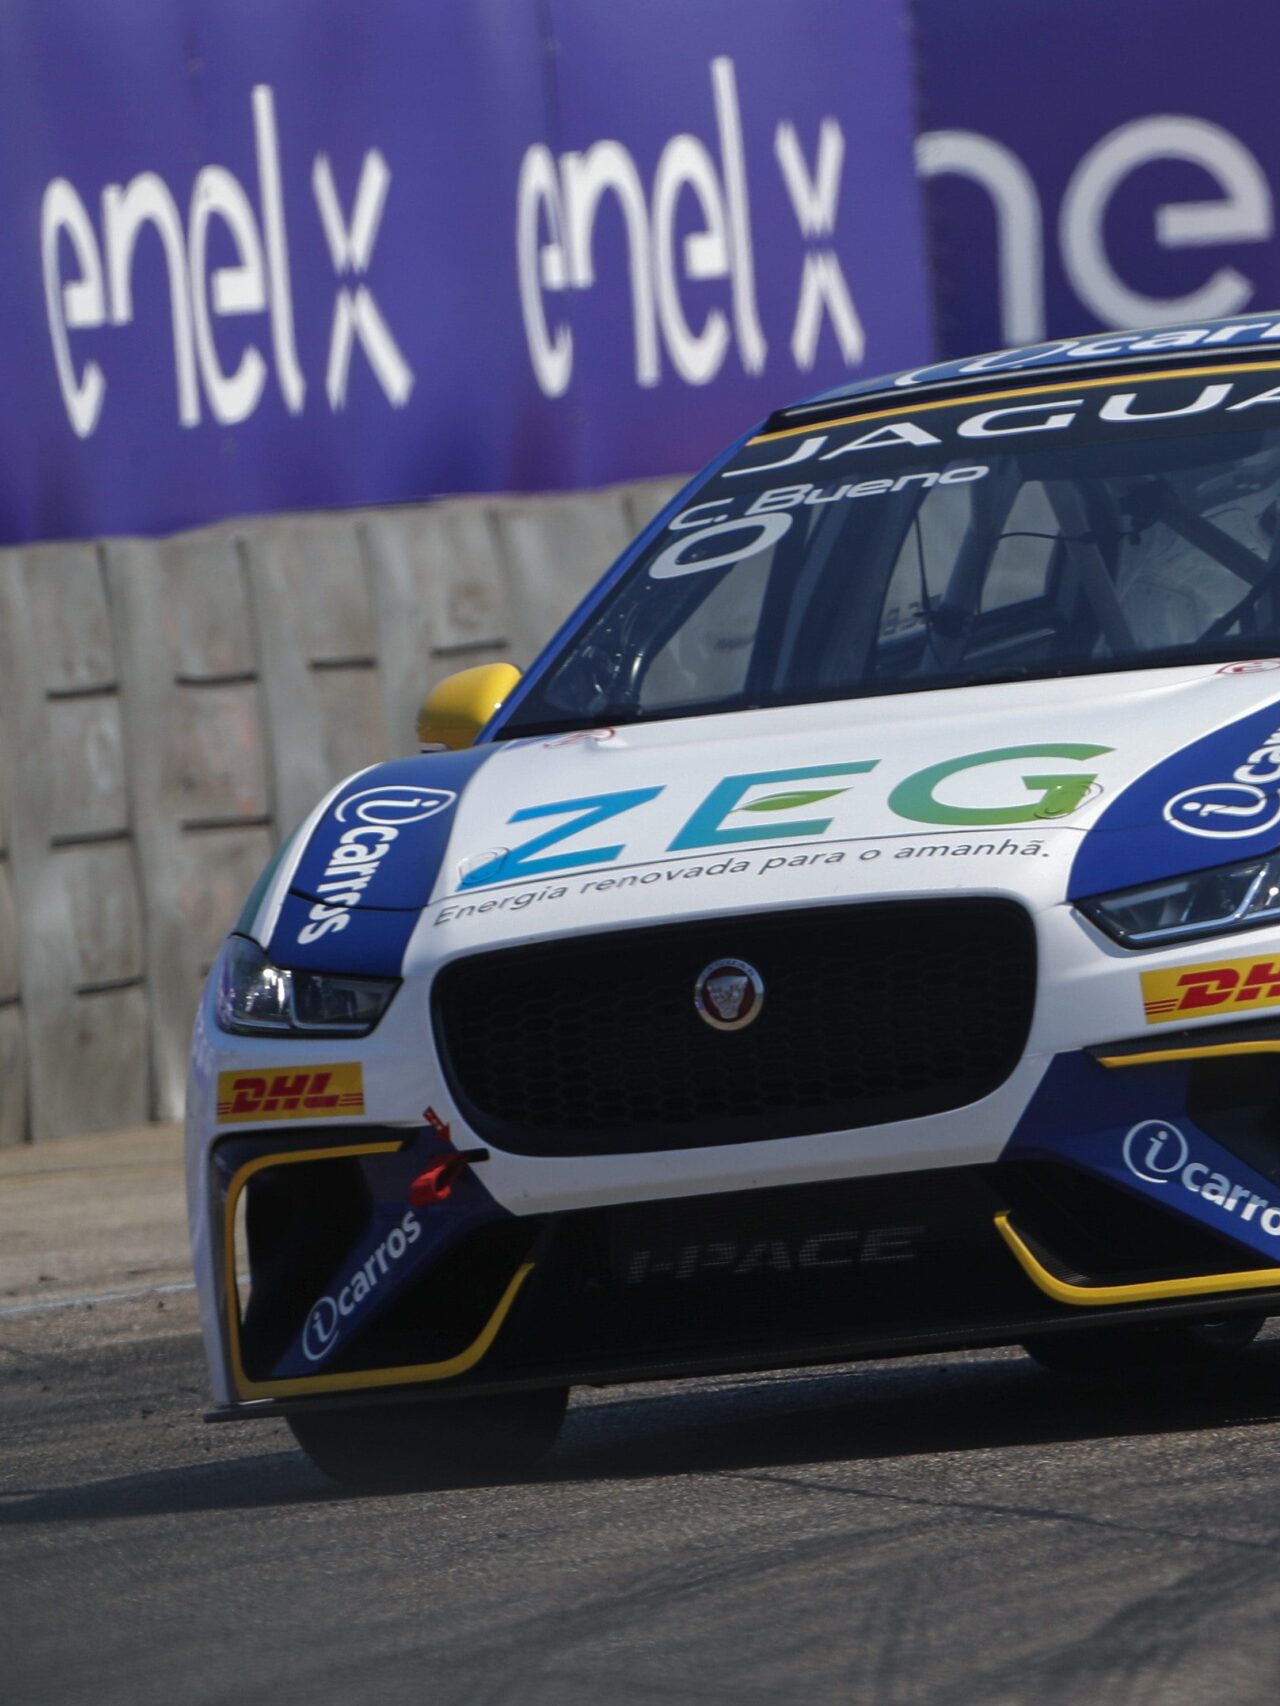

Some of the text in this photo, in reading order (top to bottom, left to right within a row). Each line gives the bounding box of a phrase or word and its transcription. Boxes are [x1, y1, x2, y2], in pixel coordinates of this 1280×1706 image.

[41, 84, 414, 438] enel x
[516, 56, 865, 398] enel x
[744, 465, 989, 516] Bueno
[456, 743, 1117, 892] ZEG
[433, 836, 1051, 926] Energia renovada para o amanhã.
[231, 1072, 341, 1114] DHL
